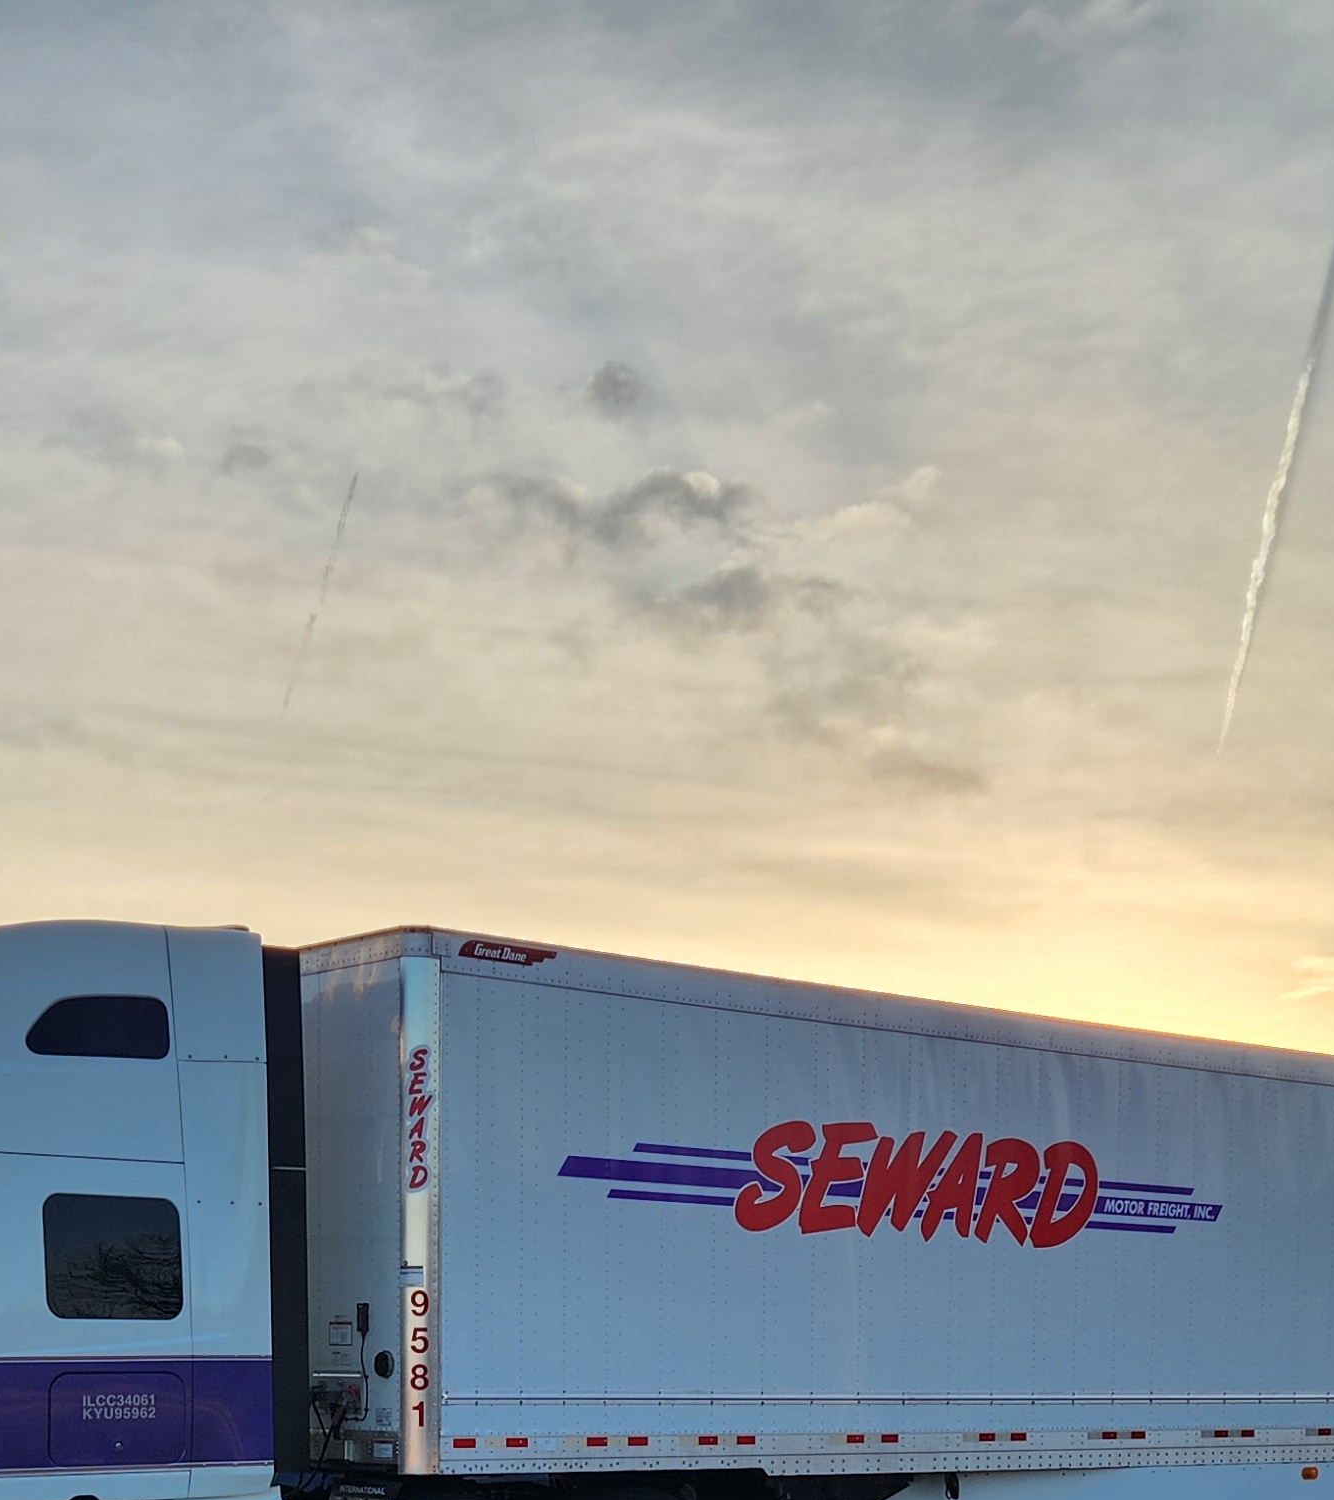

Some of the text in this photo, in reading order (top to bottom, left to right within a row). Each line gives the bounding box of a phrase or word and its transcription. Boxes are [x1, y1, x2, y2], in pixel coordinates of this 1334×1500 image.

[474, 943, 527, 962] Great Dane
[408, 1049, 432, 1189] SEWARD
[734, 1120, 1098, 1249] SEWARD
[1104, 1199, 1215, 1219] MOTOR FREIGHT, INC.
[410, 1290, 429, 1427] 9581
[82, 1394, 156, 1407] ILCC34061
[82, 1407, 156, 1419] KYU95962
